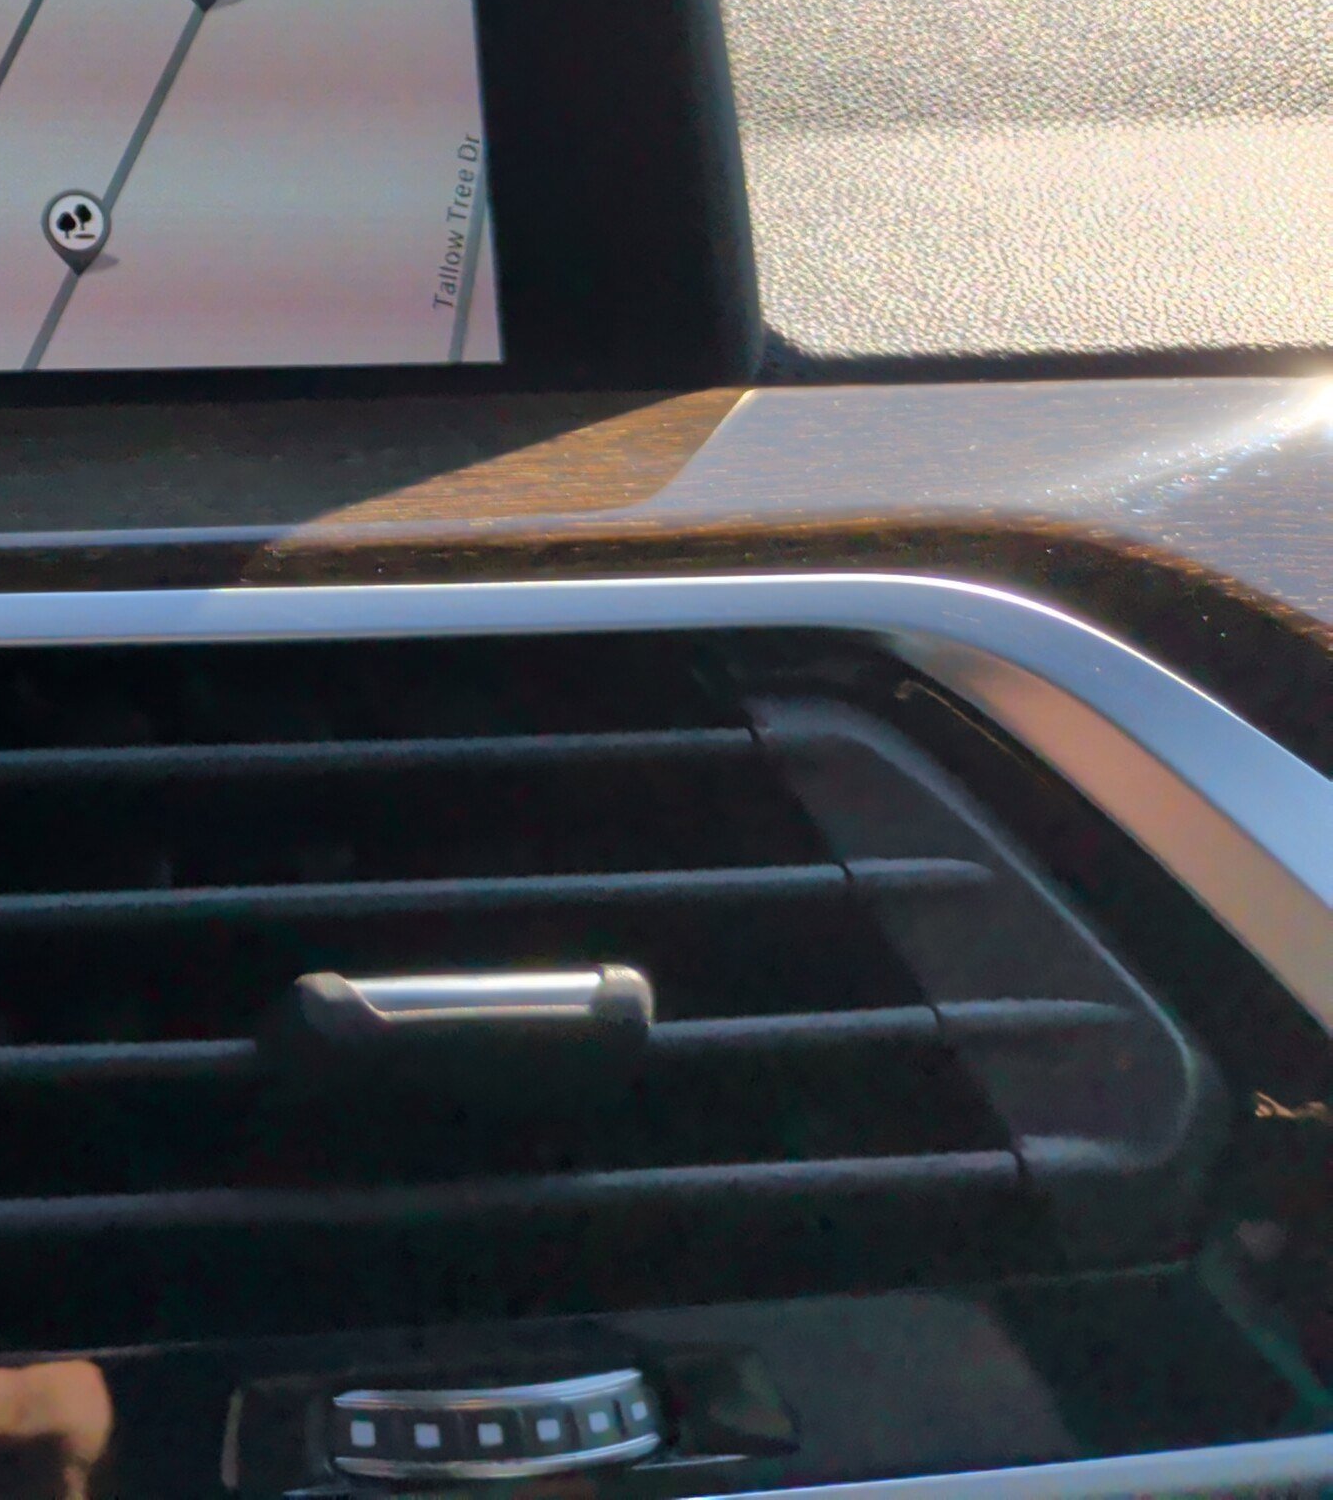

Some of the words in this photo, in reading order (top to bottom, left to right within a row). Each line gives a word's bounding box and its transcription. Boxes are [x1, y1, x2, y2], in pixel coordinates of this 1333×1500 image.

[458, 133, 481, 163] Dr
[446, 168, 475, 222] Tree
[432, 230, 464, 311] Tallow
